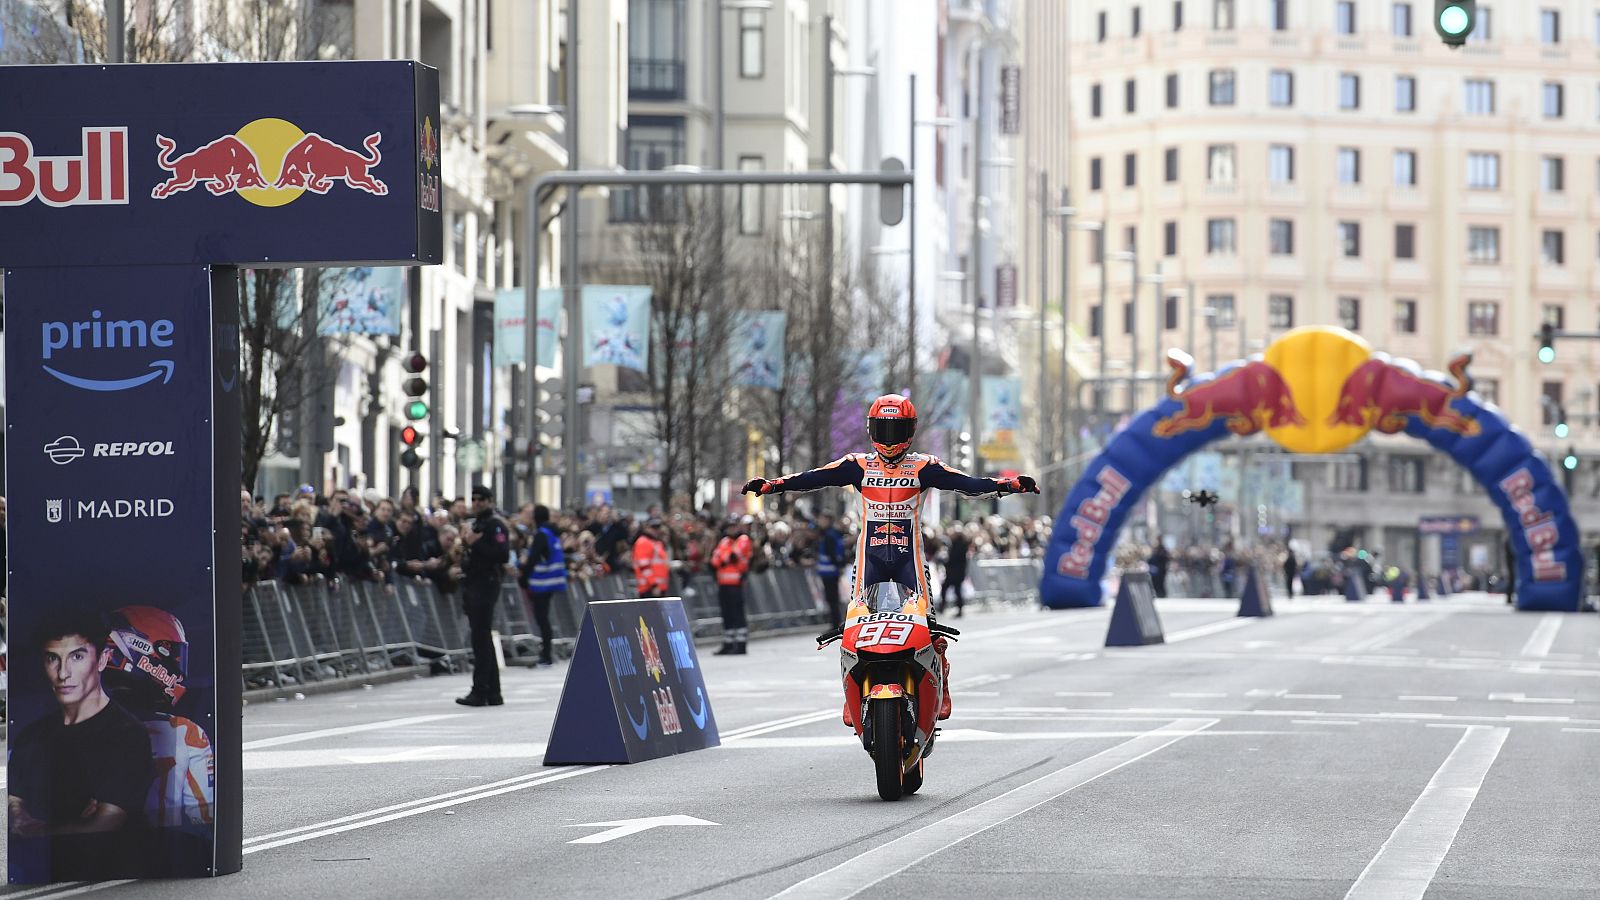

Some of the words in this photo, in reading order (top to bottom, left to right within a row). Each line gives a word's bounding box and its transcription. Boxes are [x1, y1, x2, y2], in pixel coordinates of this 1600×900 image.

[42, 310, 175, 359] prime
[93, 441, 175, 457] REPSOL
[866, 477, 917, 487] REPSOL
[1077, 464, 1133, 527] Bull
[78, 499, 175, 519] MADRID
[868, 503, 913, 511] HONDA
[1499, 467, 1553, 528] Red
[870, 535, 889, 546] Red
[890, 535, 909, 546] Bull
[1057, 515, 1103, 580] Red
[1524, 520, 1567, 581] Bull
[857, 612, 915, 623] REPSOL
[854, 620, 915, 649] 93
[137, 655, 163, 677] Red
[156, 665, 178, 688] Bull
